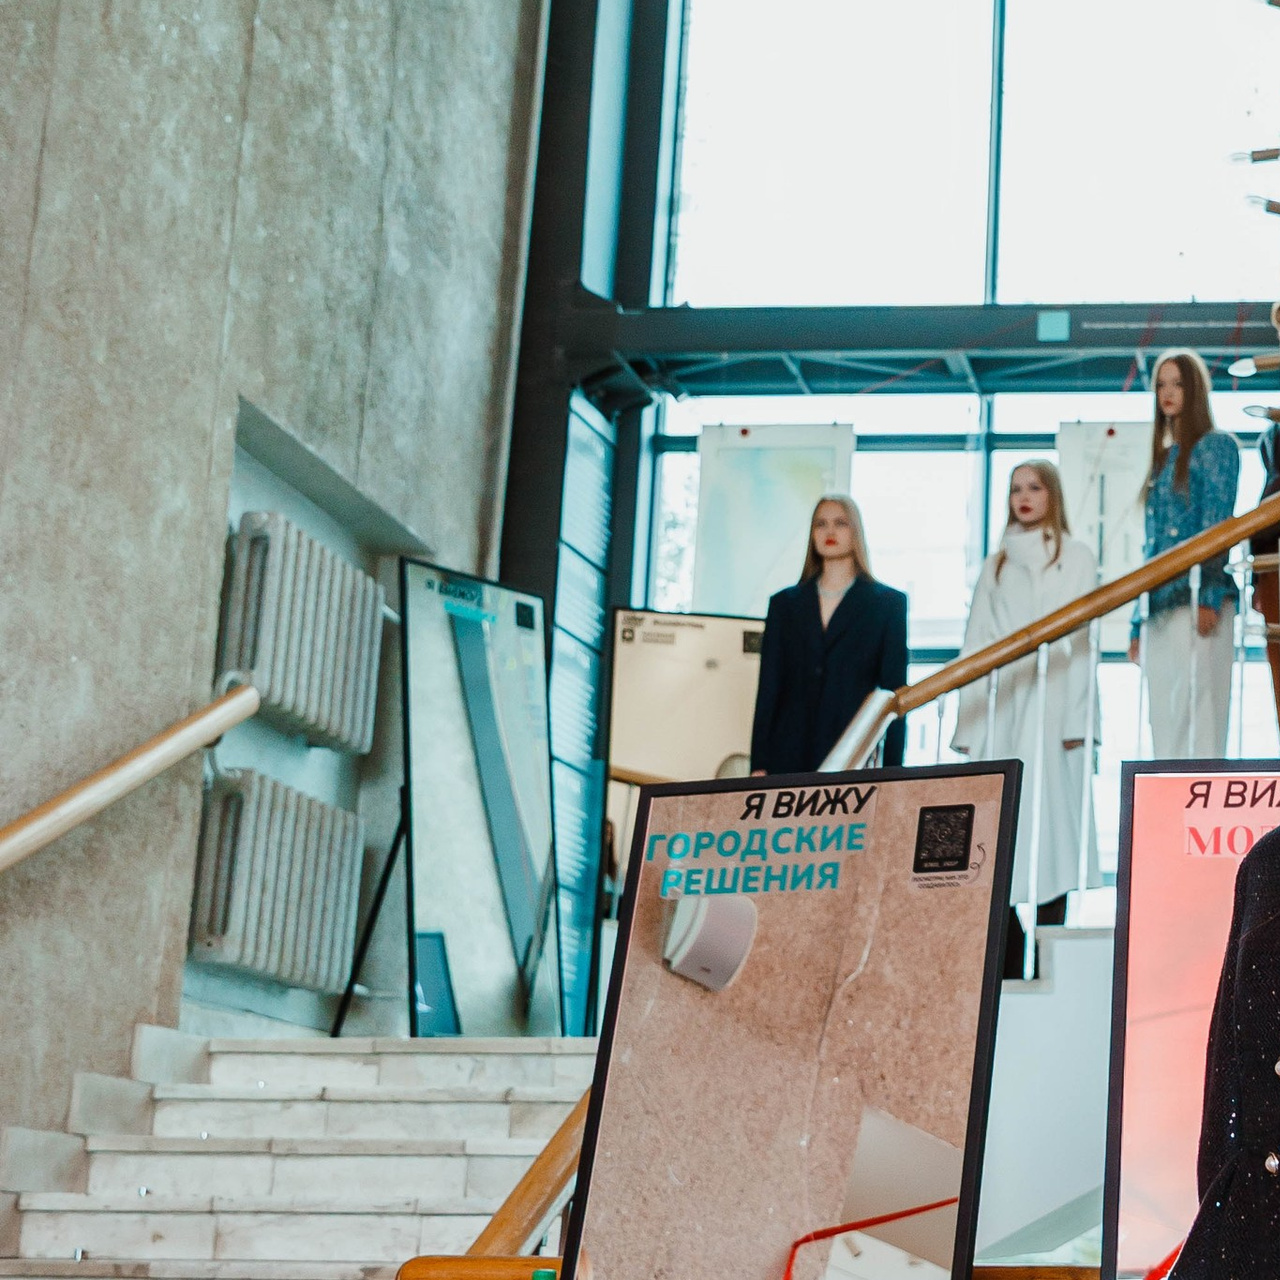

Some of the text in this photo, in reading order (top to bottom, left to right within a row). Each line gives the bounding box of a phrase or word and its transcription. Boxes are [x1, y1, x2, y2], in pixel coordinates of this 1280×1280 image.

[740, 785, 877, 820] Я ВИЖУ
[1185, 781, 1212, 808] Я
[646, 823, 867, 863] ГОРОДСКИЕ
[1187, 825, 1276, 855] МО
[660, 861, 841, 898] РЕШЕНИЯ
